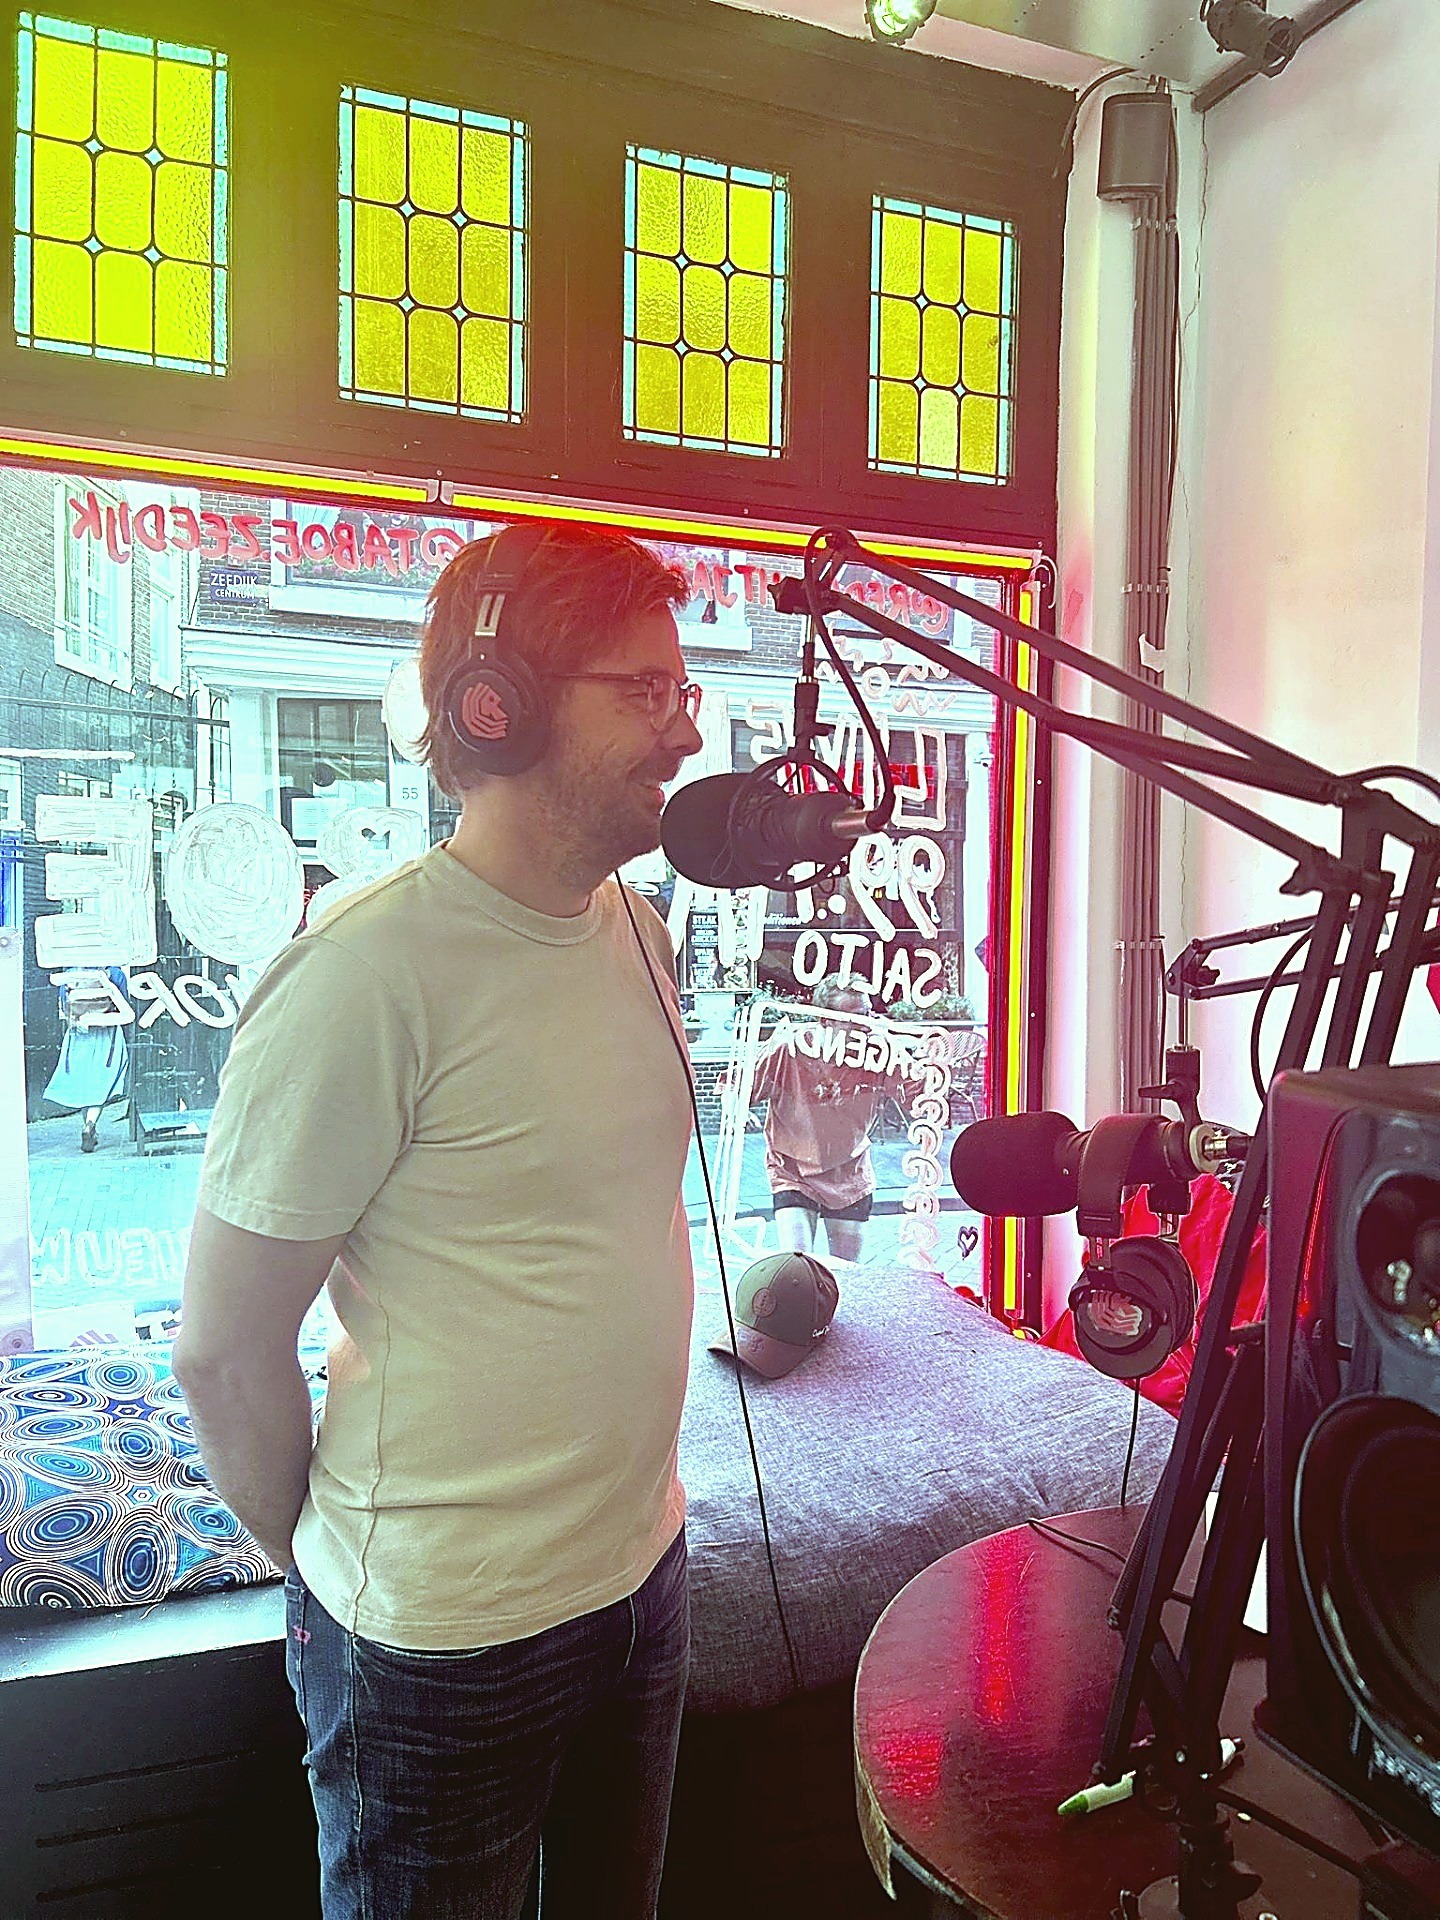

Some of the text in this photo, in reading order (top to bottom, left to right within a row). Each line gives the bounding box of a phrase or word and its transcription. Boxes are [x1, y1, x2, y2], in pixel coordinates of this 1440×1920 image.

[210, 572, 258, 587] ZEEDIJK
[214, 588, 255, 600] CENTRUM
[402, 787, 419, 801] 55
